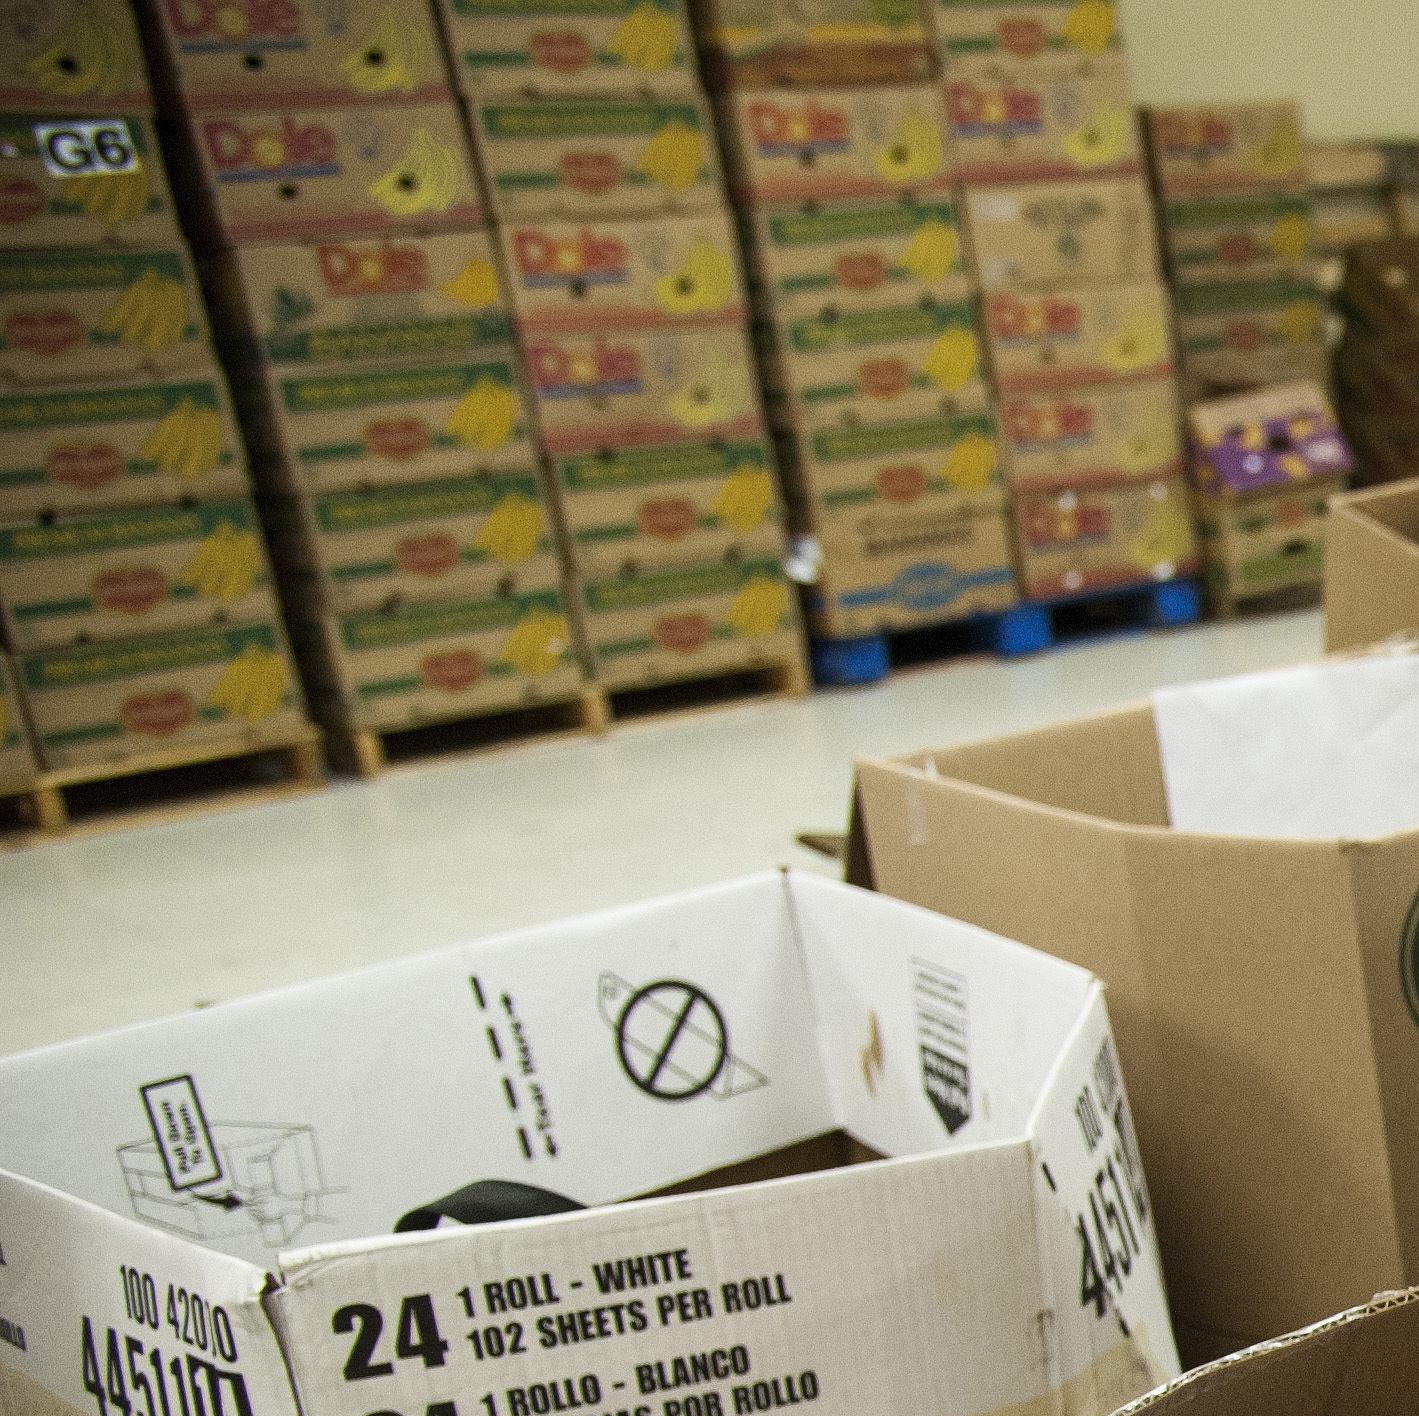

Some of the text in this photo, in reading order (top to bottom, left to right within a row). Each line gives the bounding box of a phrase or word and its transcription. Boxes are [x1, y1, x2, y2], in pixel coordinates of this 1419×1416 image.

[48, 126, 132, 173] G6
[205, 118, 338, 168] Dole
[317, 240, 428, 294] Dole
[512, 230, 627, 274] Dole
[528, 345, 642, 391] Dole
[119, 1265, 160, 1330] 100
[455, 1248, 693, 1318] 1 ROLL WHITE
[331, 1292, 449, 1382] 24
[466, 1273, 793, 1362] 102 SHEETS PER ROLL
[634, 1344, 752, 1396] BLANCO
[730, 1370, 820, 1416] ROLLO
